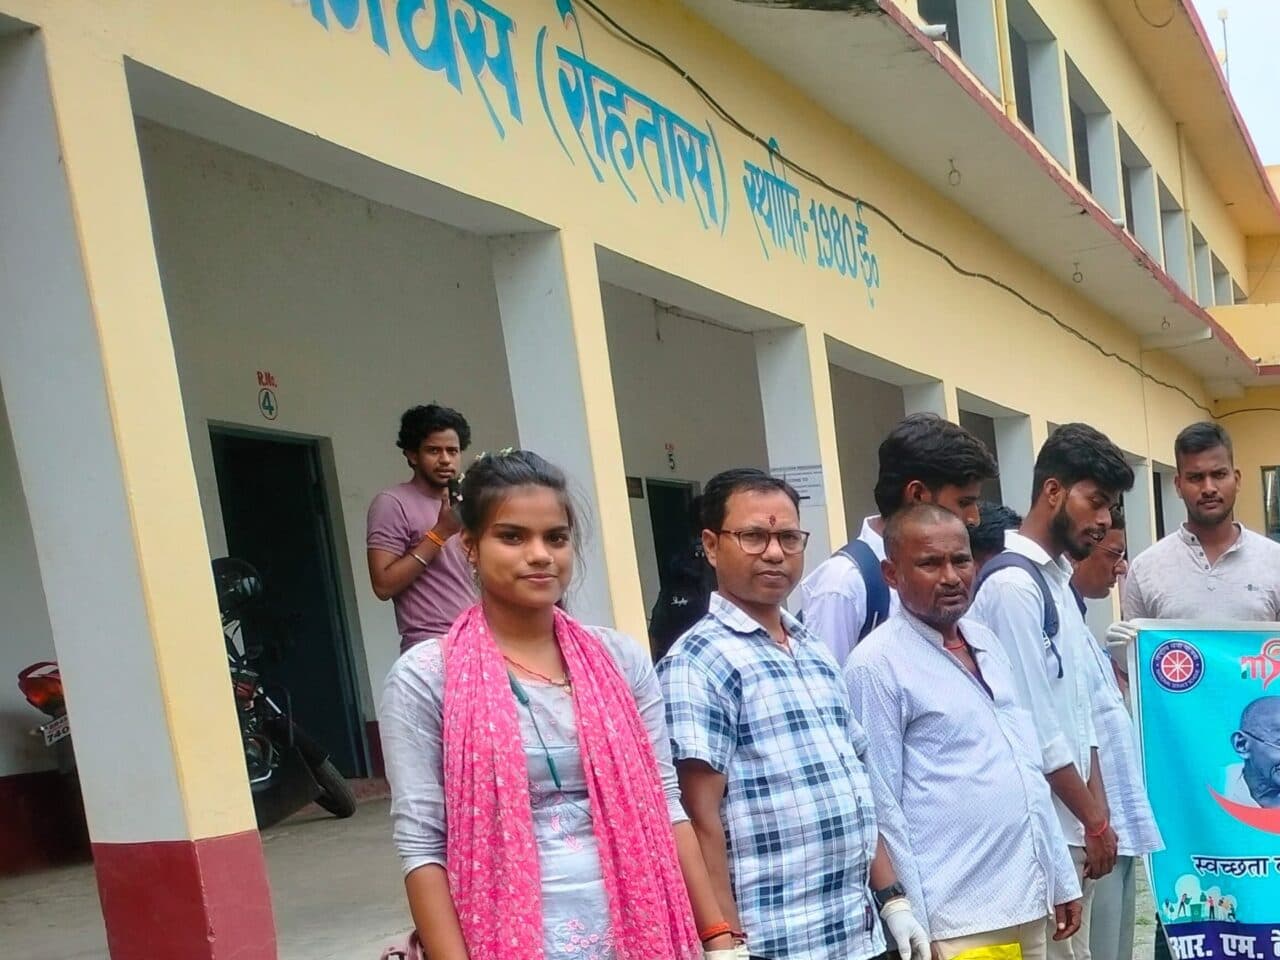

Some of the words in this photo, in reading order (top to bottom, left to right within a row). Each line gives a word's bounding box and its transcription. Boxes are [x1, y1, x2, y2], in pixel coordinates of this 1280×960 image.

[261, 391, 275, 416] 4
[1192, 855, 1270, 877] स्वच्छता
[1219, 932, 1264, 960] एम.
